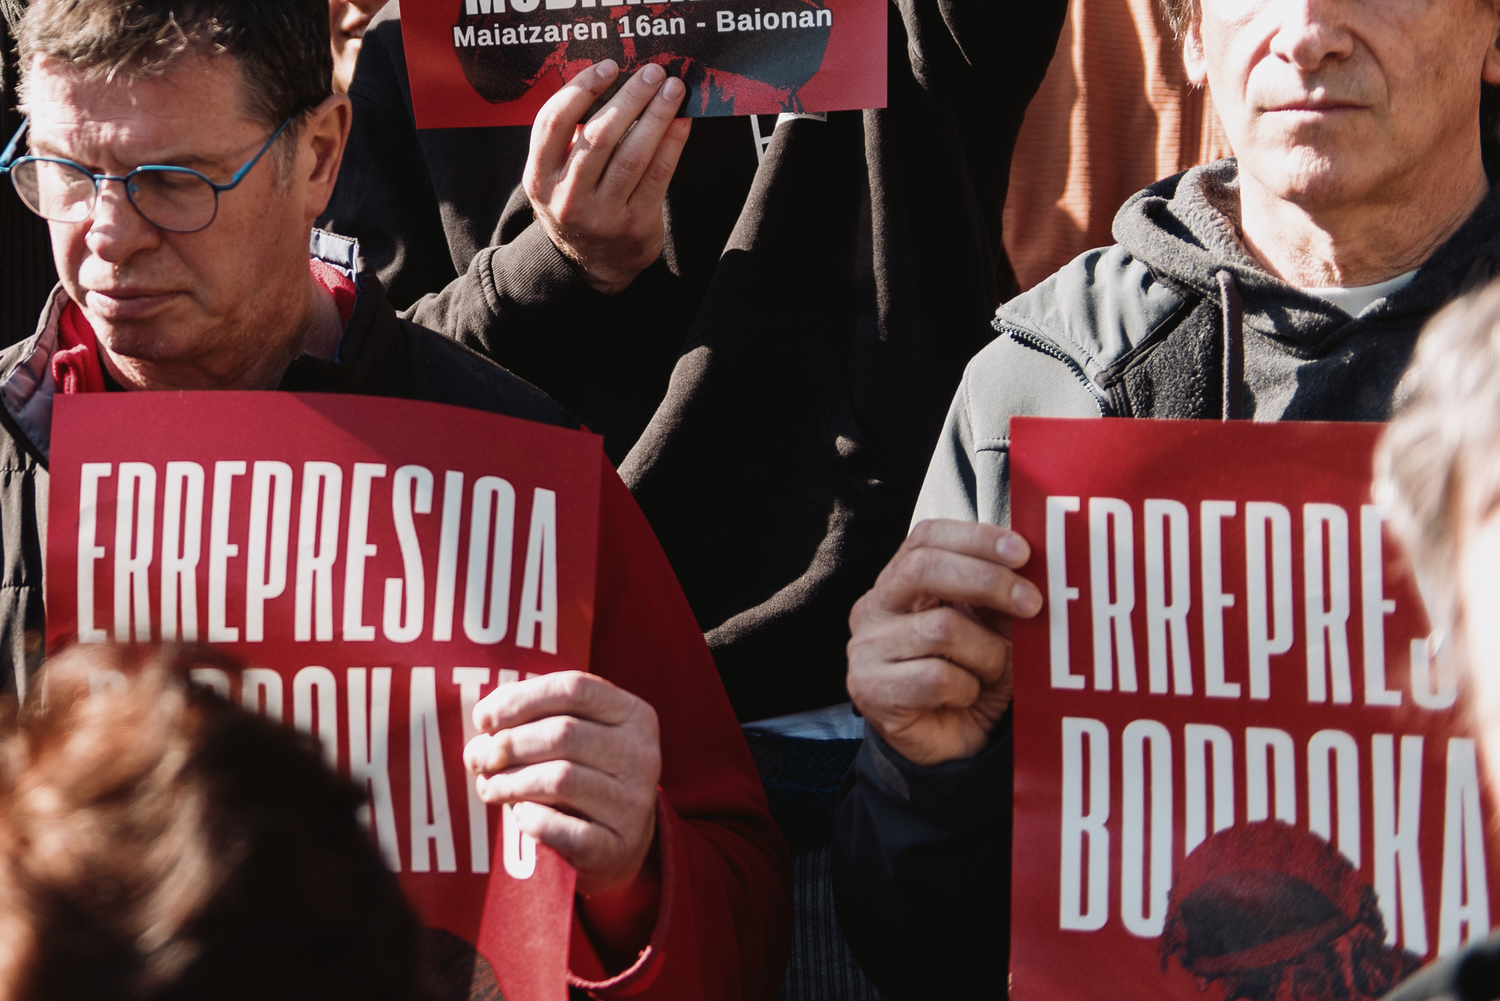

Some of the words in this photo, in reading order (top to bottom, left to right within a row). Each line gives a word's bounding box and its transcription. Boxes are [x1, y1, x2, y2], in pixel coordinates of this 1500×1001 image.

[453, 21, 608, 48] Maiatzaren
[618, 13, 686, 39] 16an
[717, 7, 833, 33] Baionan
[77, 460, 559, 655] ERREPRESIOA
[1059, 716, 1490, 958] BOROKA
